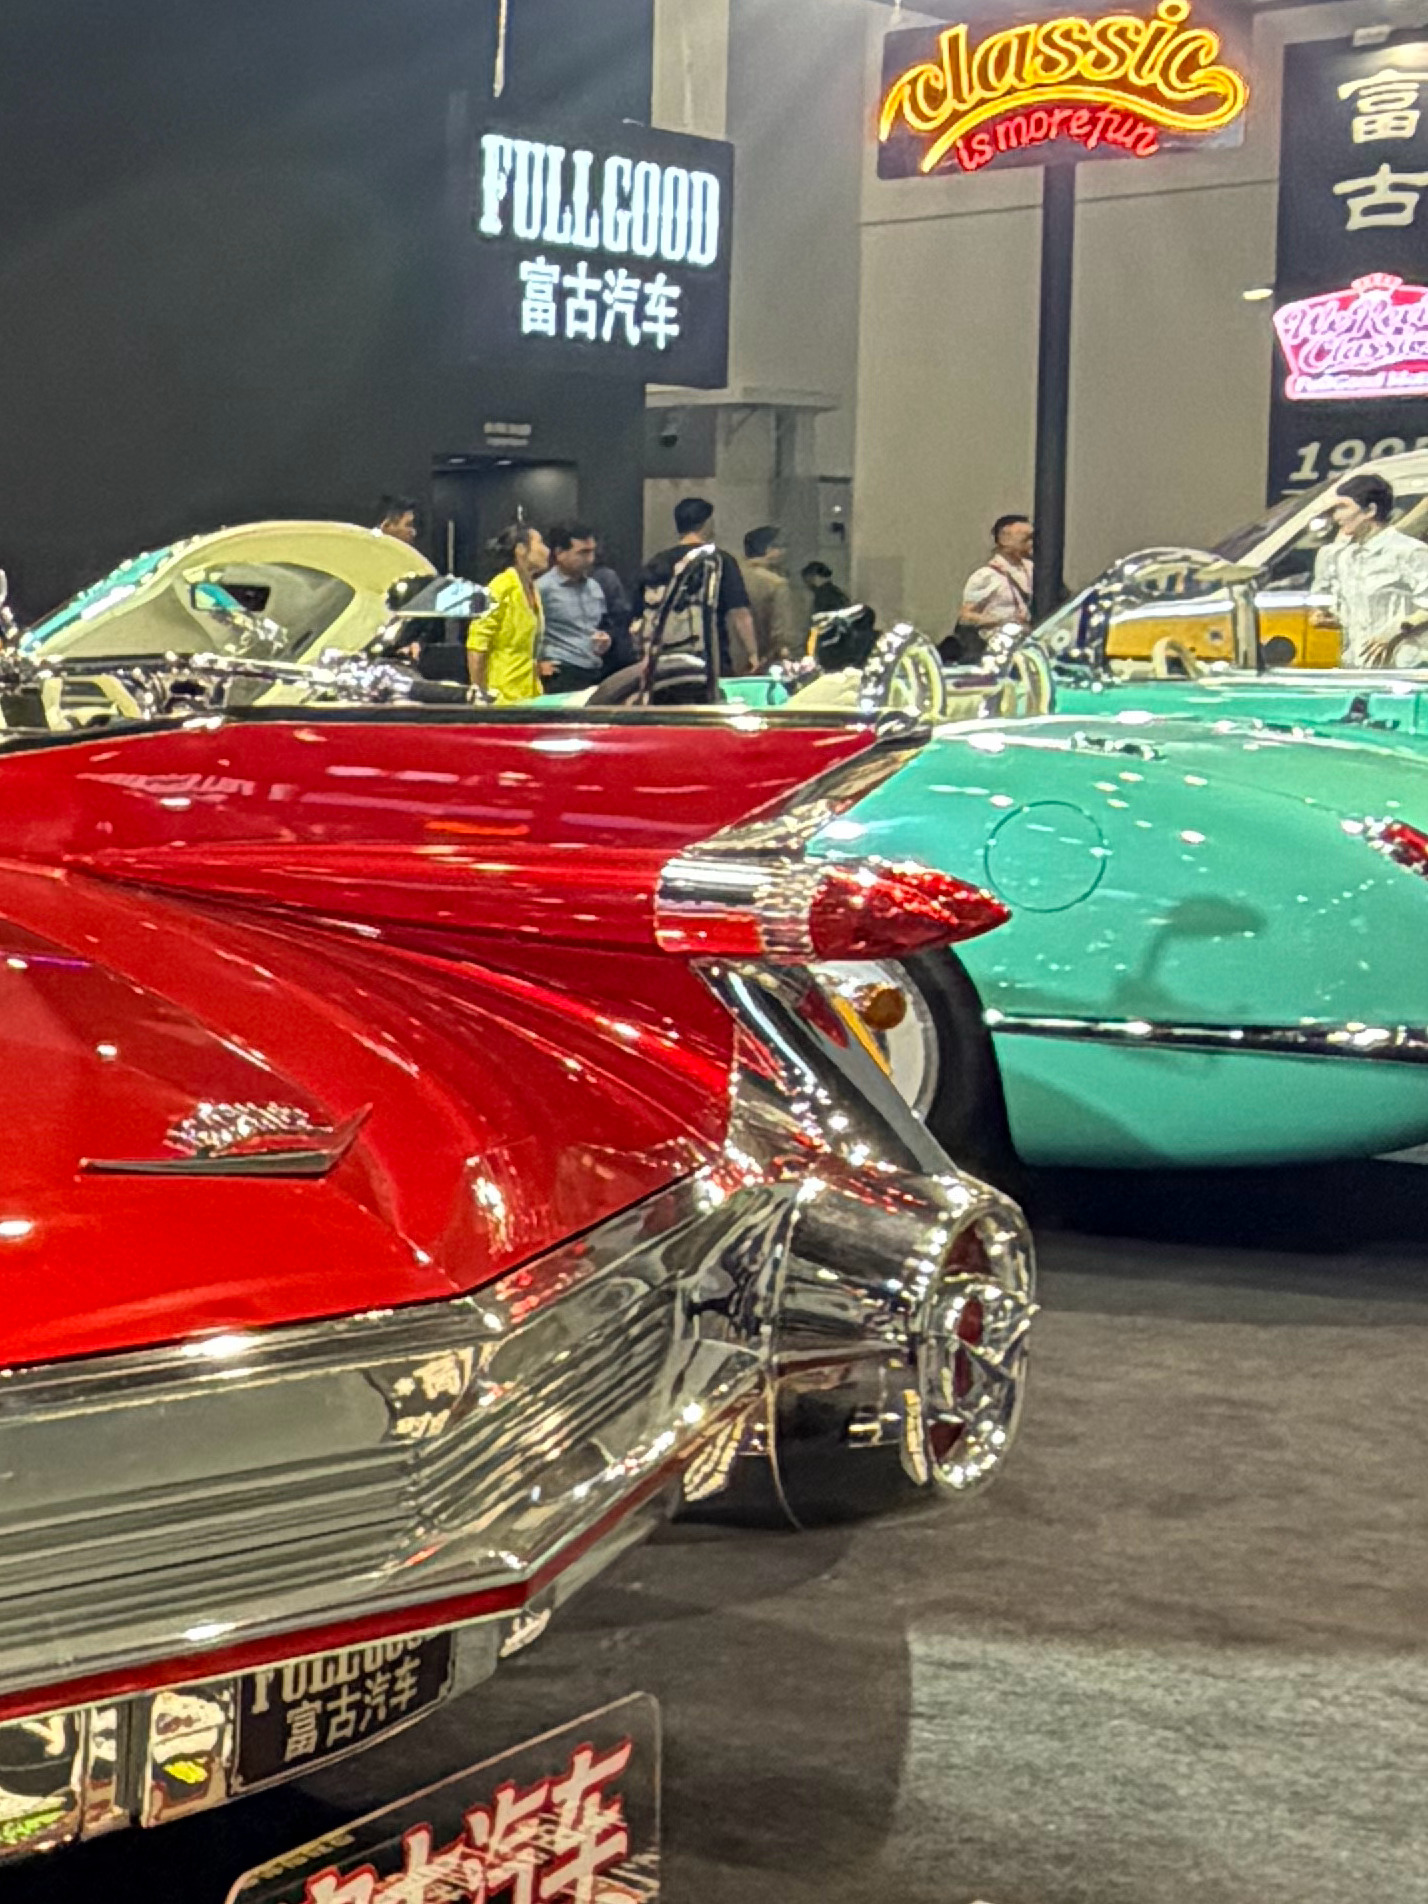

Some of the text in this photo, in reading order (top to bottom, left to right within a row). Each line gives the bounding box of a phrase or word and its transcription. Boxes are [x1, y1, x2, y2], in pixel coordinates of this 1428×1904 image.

[956, 106, 1160, 172] is more fun
[479, 133, 720, 266] FULLGOOD
[519, 255, 682, 350] 富古汽车
[284, 1656, 421, 1762] 富古汽车
